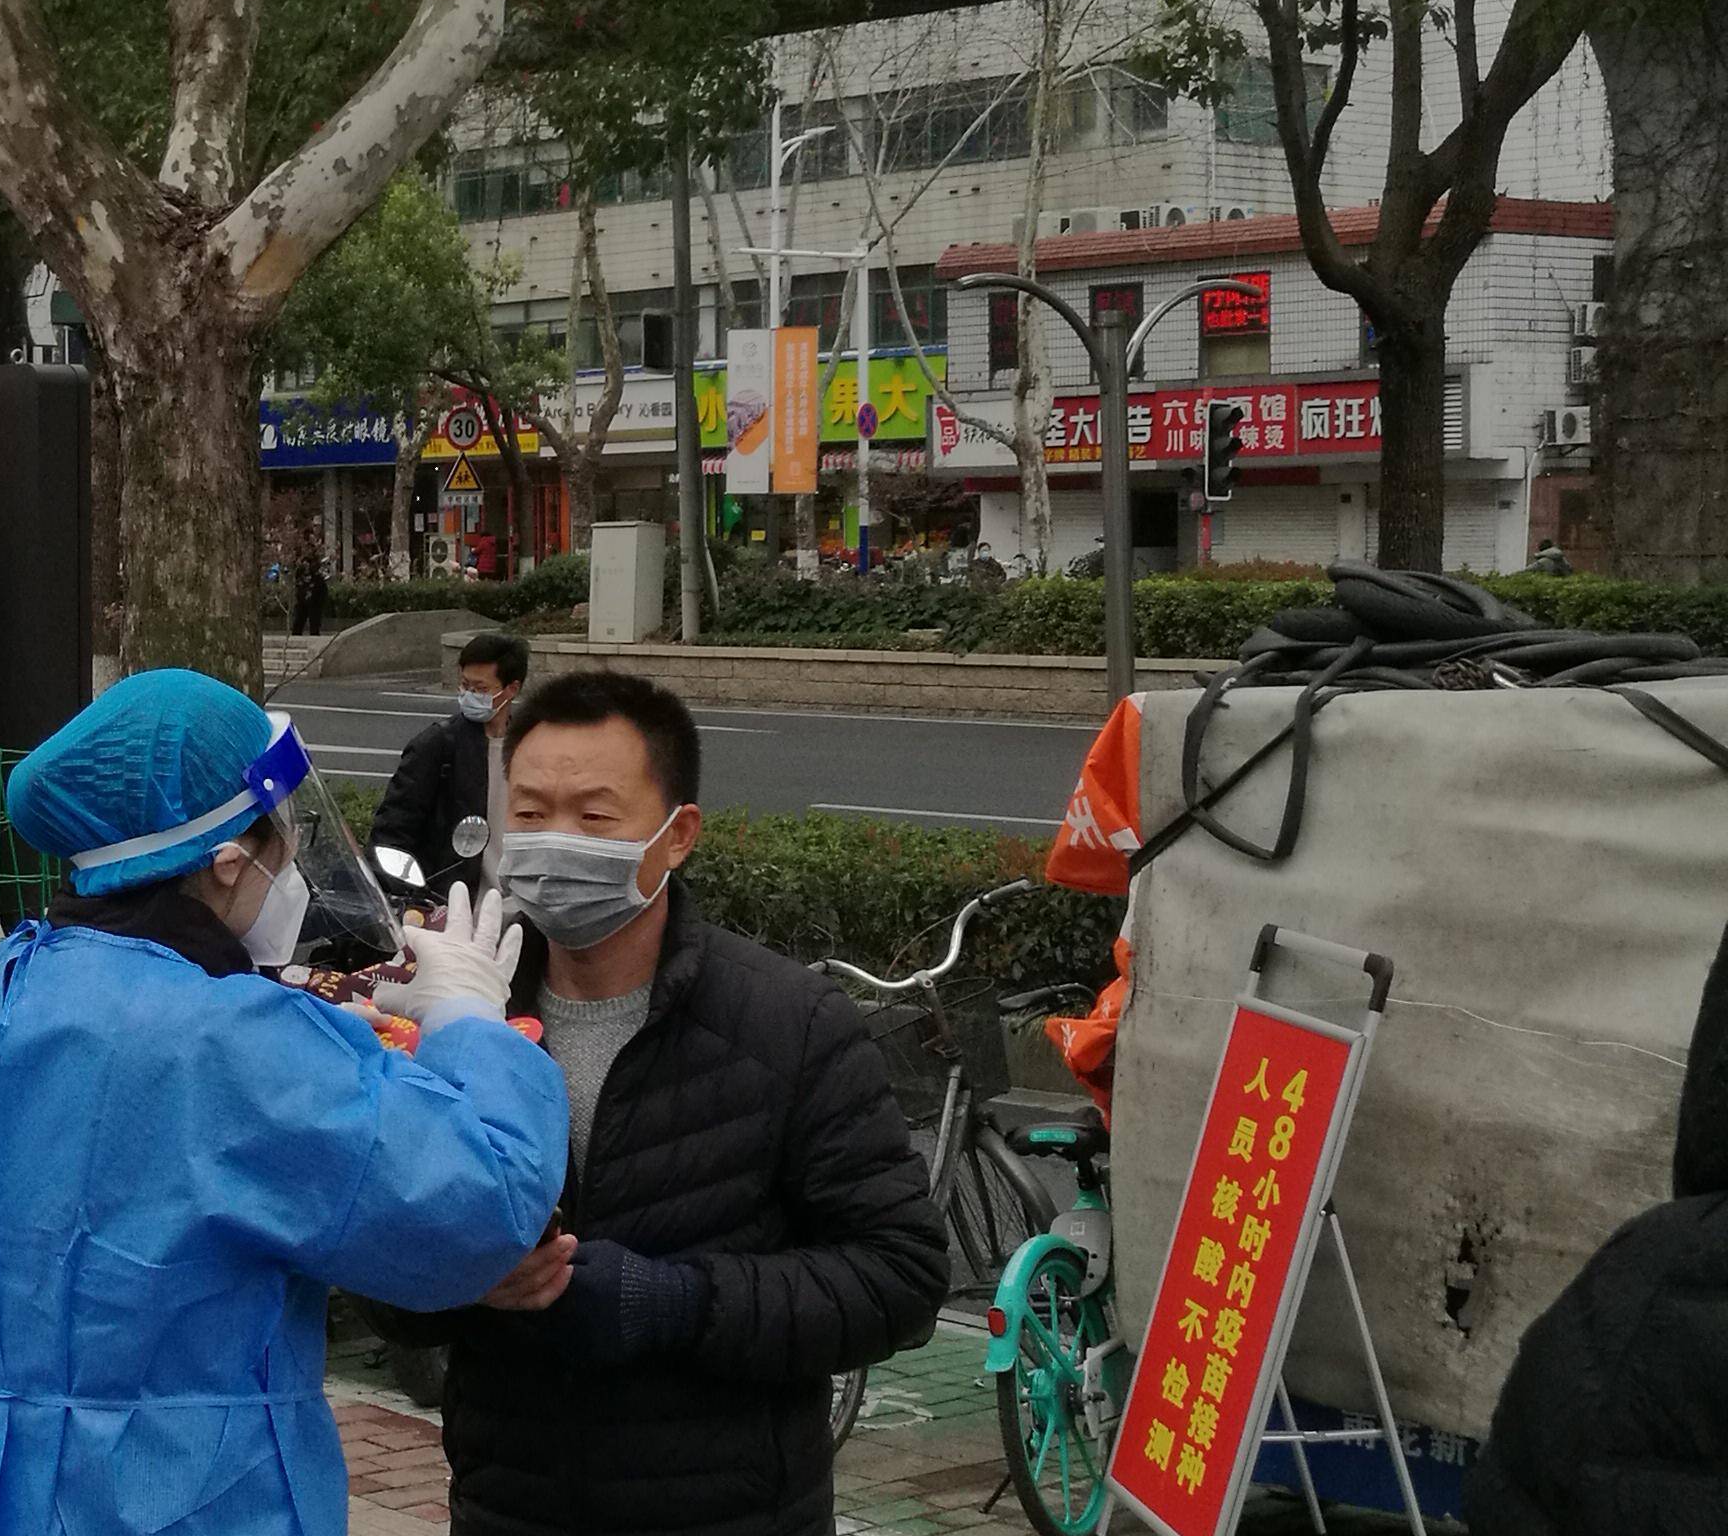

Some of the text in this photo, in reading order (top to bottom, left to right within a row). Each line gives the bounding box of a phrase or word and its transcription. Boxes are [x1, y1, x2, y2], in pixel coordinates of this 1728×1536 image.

[454, 419, 475, 439] 30
[544, 406, 583, 418] Aroa
[587, 402, 633, 421] Bry
[1045, 404, 1153, 447] 圣大告
[1166, 425, 1285, 452] 川味辣烫
[1143, 1056, 1270, 1473] 人员核酸不检测
[1175, 1067, 1309, 1496] 48小时内疫苗接种
